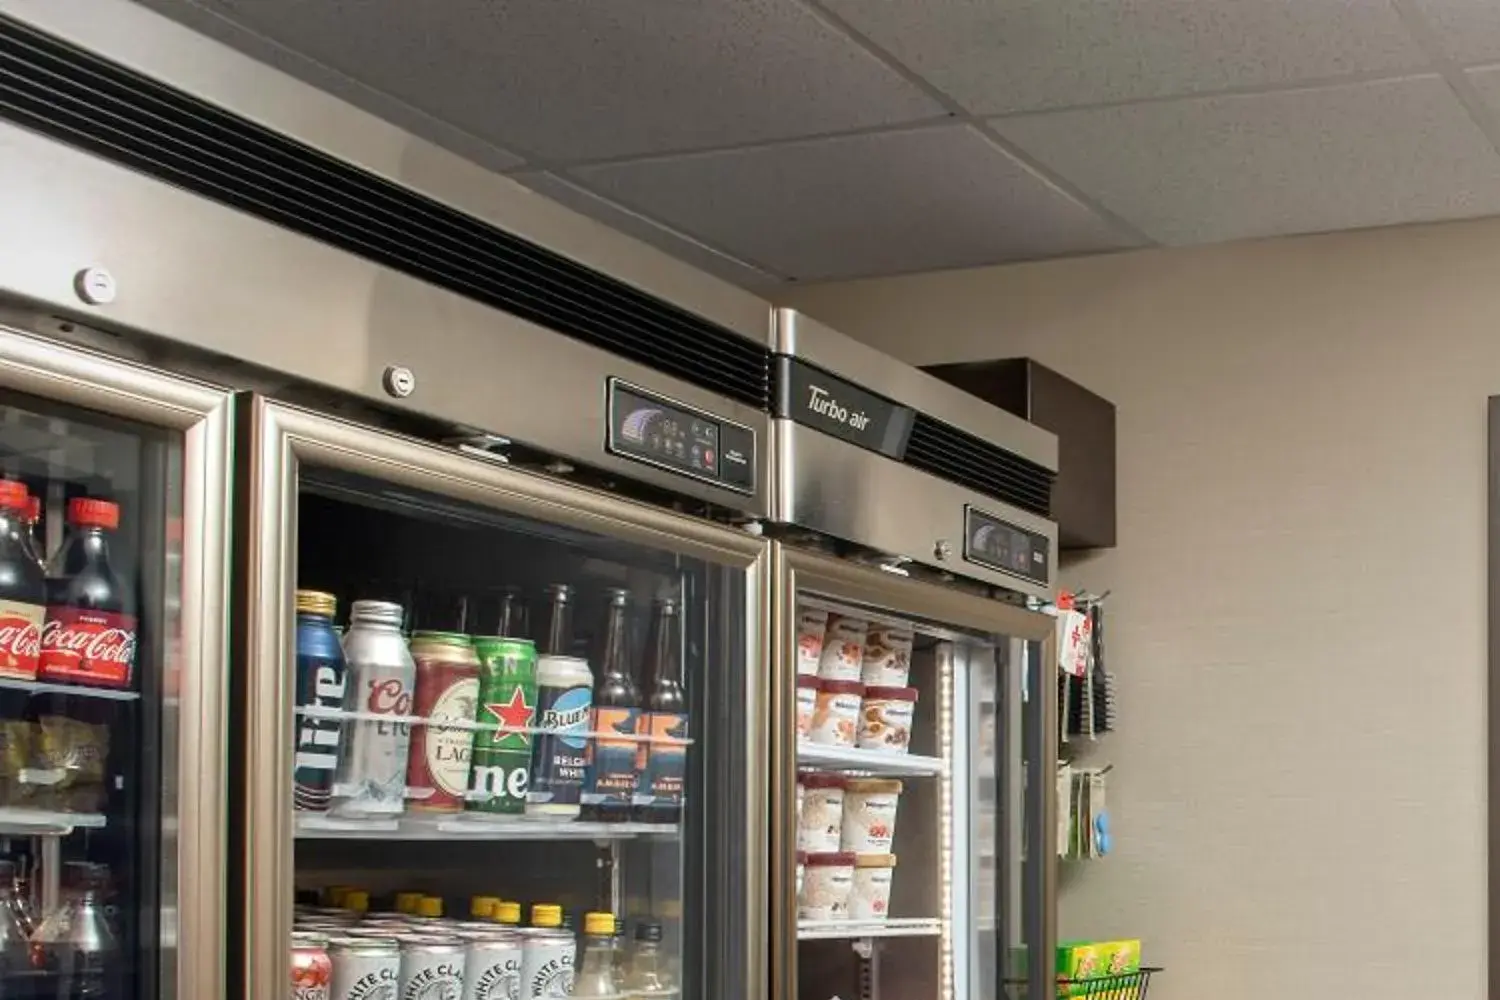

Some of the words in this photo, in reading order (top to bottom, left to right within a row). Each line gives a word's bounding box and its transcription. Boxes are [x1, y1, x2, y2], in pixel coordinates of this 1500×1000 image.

[808, 385, 848, 423] Turbo
[849, 411, 871, 431] air
[43, 619, 137, 664] Coca-Cola
[531, 957, 557, 998] WHITE
